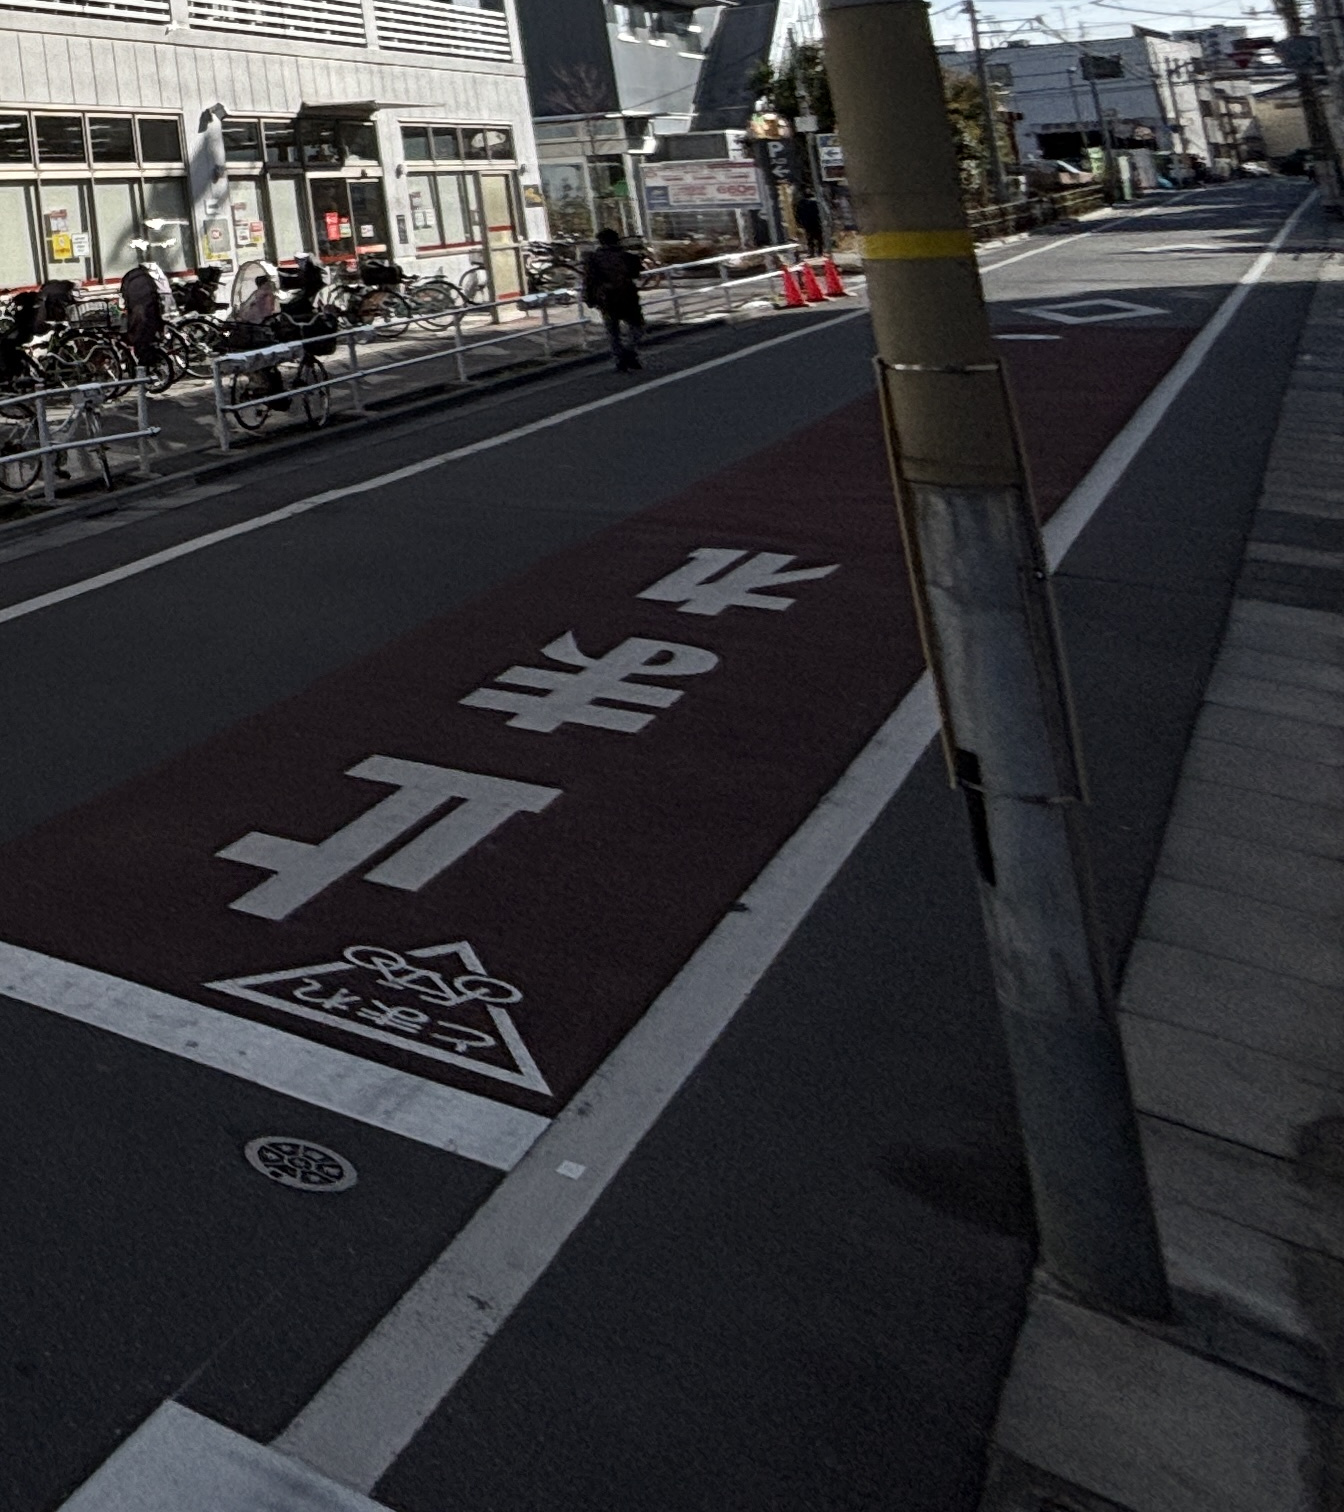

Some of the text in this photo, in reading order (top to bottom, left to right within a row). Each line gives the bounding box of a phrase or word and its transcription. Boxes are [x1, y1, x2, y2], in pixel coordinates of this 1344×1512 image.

[768, 141, 785, 157] P
[292, 978, 497, 1053] とまれ
